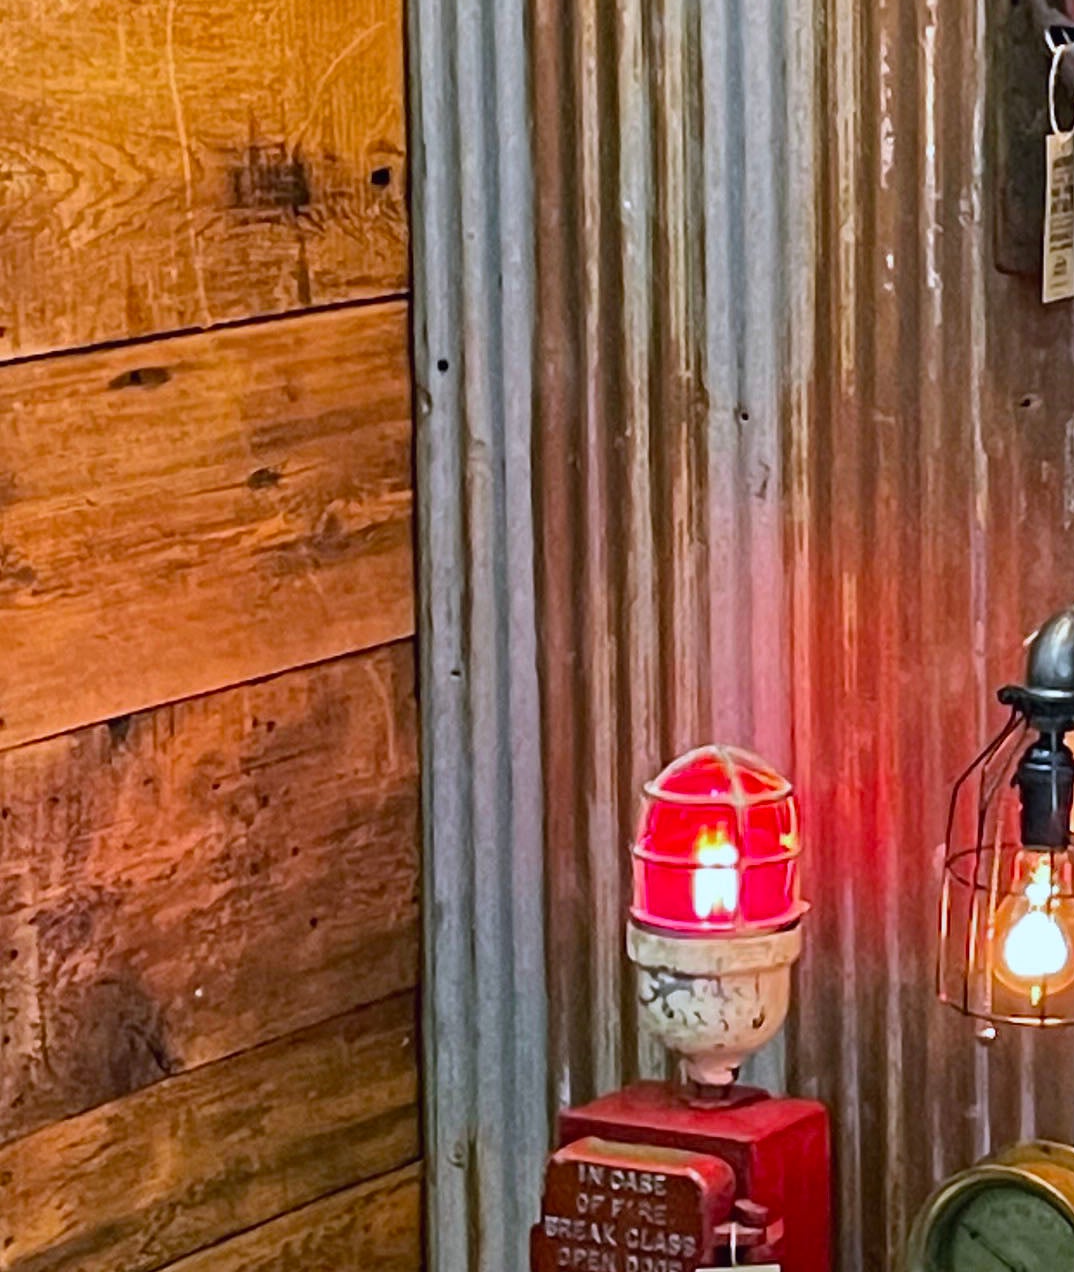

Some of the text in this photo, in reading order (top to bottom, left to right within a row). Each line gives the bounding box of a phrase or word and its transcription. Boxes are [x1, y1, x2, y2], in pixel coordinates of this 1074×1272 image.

[578, 1163, 667, 1196] IN CASE
[576, 1193, 605, 1215] OF
[544, 1215, 696, 1258] BREAK GLASS
